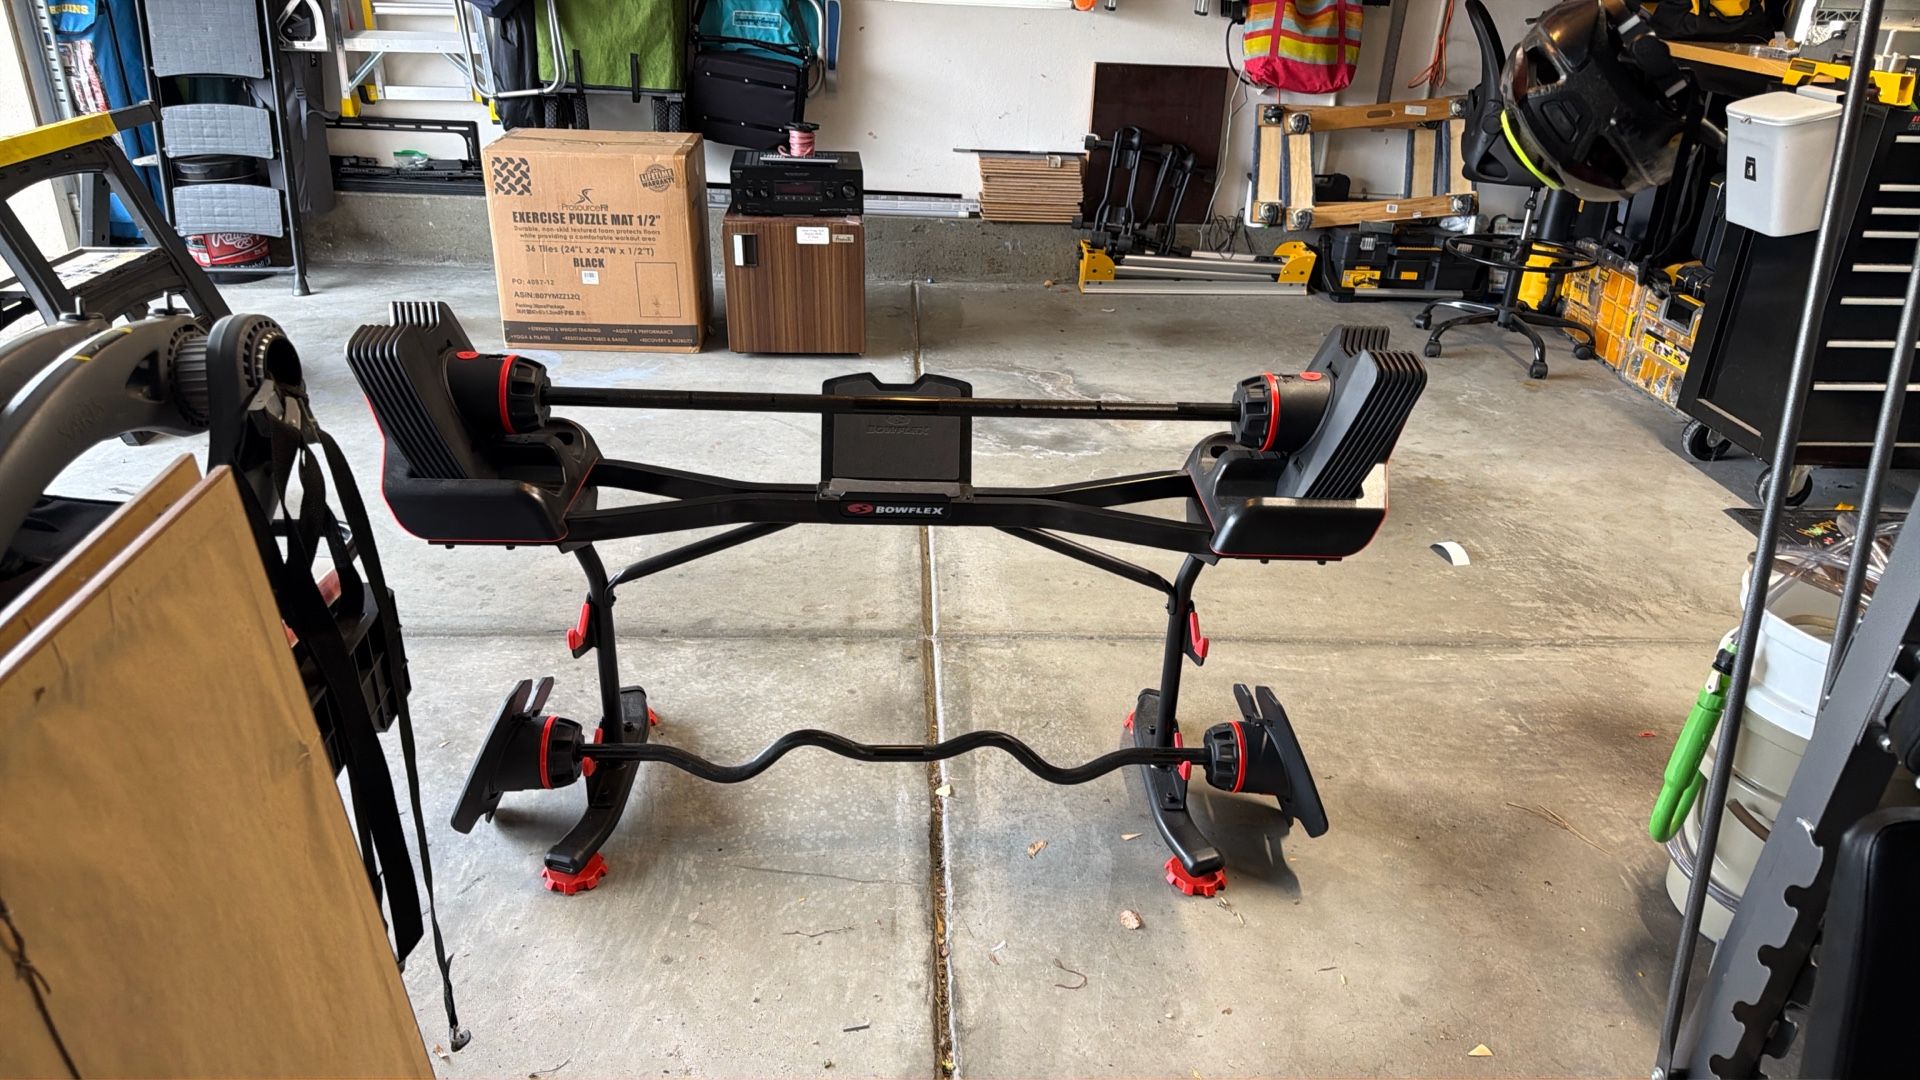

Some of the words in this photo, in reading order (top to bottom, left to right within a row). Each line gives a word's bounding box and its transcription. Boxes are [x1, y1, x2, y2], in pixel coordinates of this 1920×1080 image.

[639, 168, 674, 182] LIFETIME
[642, 177, 675, 188] WARRANTY
[512, 211, 566, 224] EXERCISE
[569, 212, 608, 225] PUZZLE
[610, 214, 634, 226] MAT
[637, 214, 661, 227] 1/2"
[525, 244, 536, 252] 36
[538, 245, 558, 253] Tiles
[561, 245, 583, 255] (24"L
[594, 246, 617, 254] 24"W
[573, 257, 605, 268] BLACK
[875, 505, 944, 515] BOWFLEX
